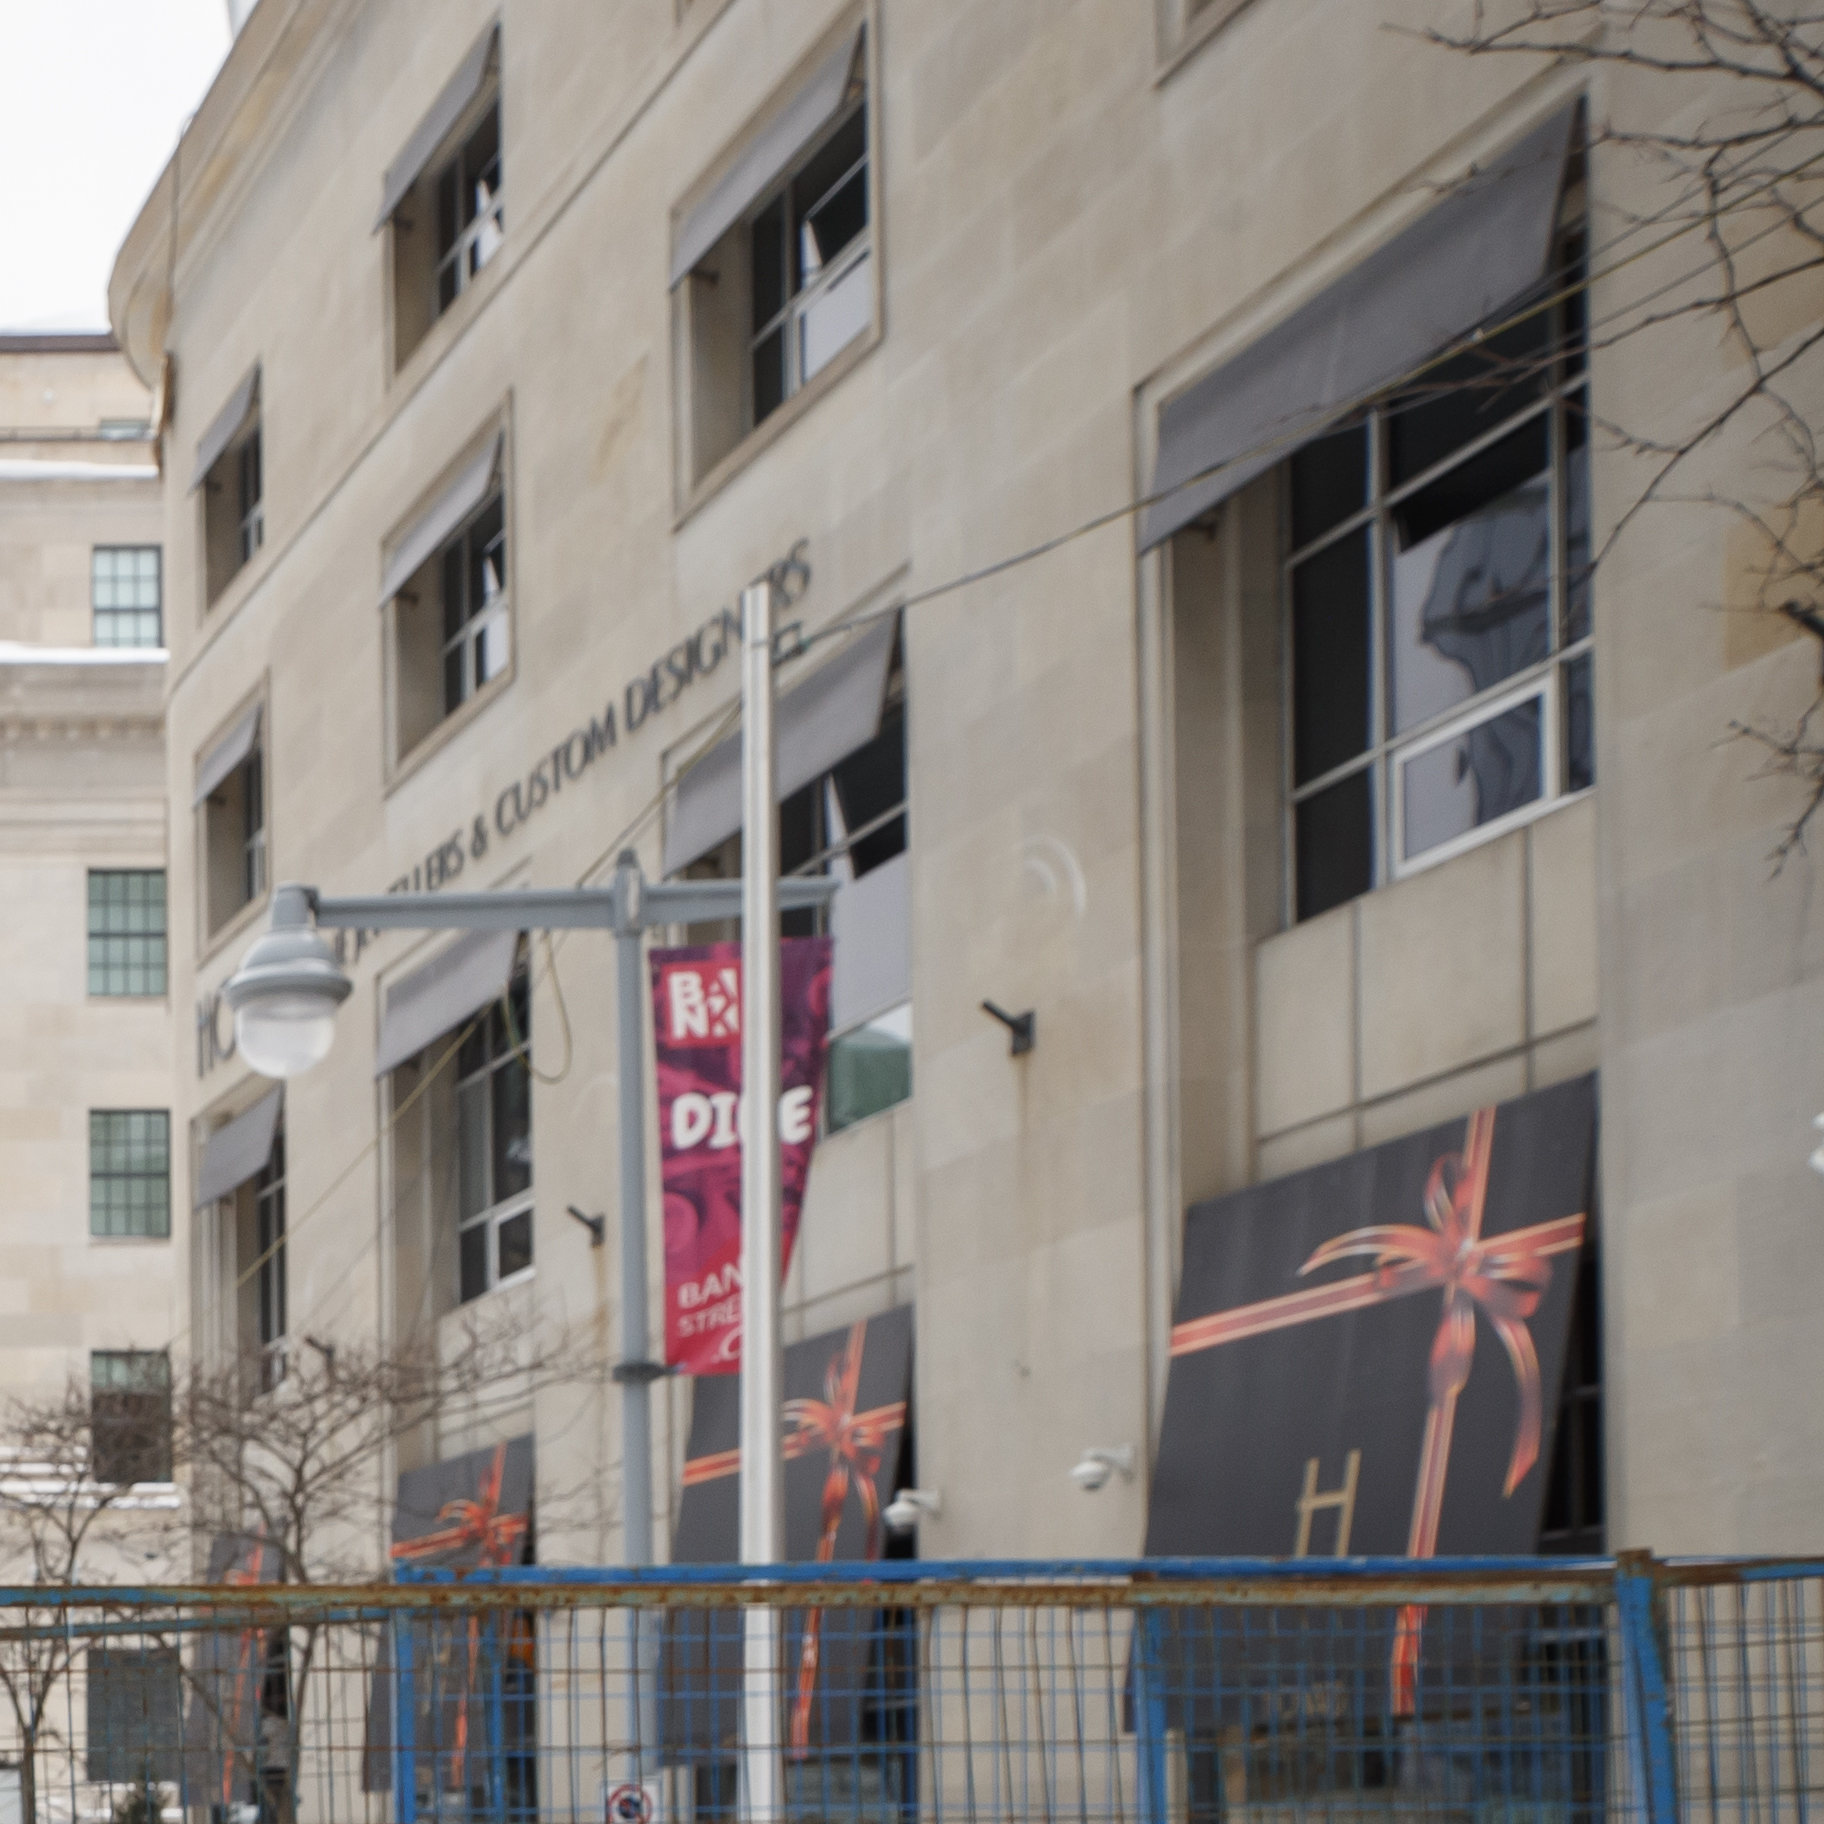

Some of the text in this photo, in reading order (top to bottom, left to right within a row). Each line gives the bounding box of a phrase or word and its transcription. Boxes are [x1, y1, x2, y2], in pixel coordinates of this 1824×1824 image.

[470, 812, 489, 858] &
[493, 700, 617, 838] CUSTOM
[623, 536, 812, 734] DESIGNRS
[671, 1085, 814, 1150] DIE
